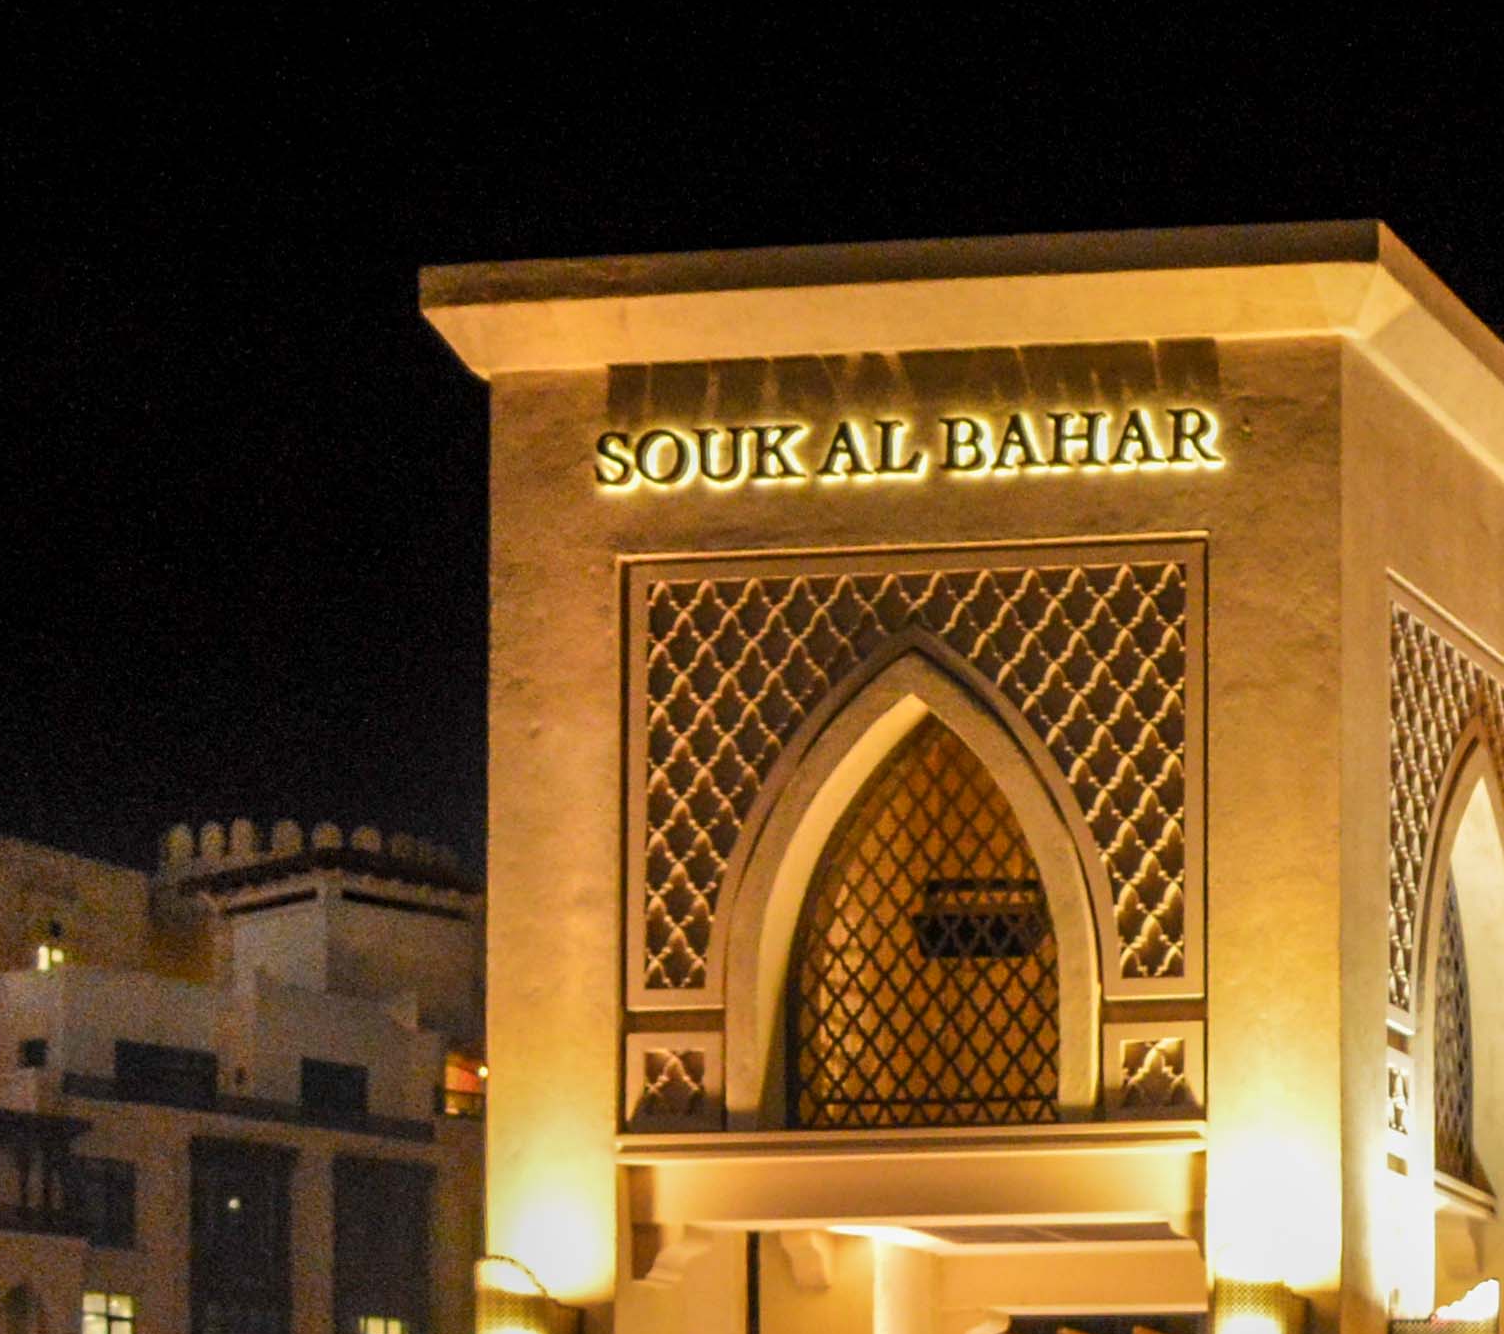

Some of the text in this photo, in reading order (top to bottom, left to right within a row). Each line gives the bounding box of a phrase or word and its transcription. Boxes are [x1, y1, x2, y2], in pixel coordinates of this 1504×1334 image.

[593, 407, 1222, 491] SOUK AL BAHAR
